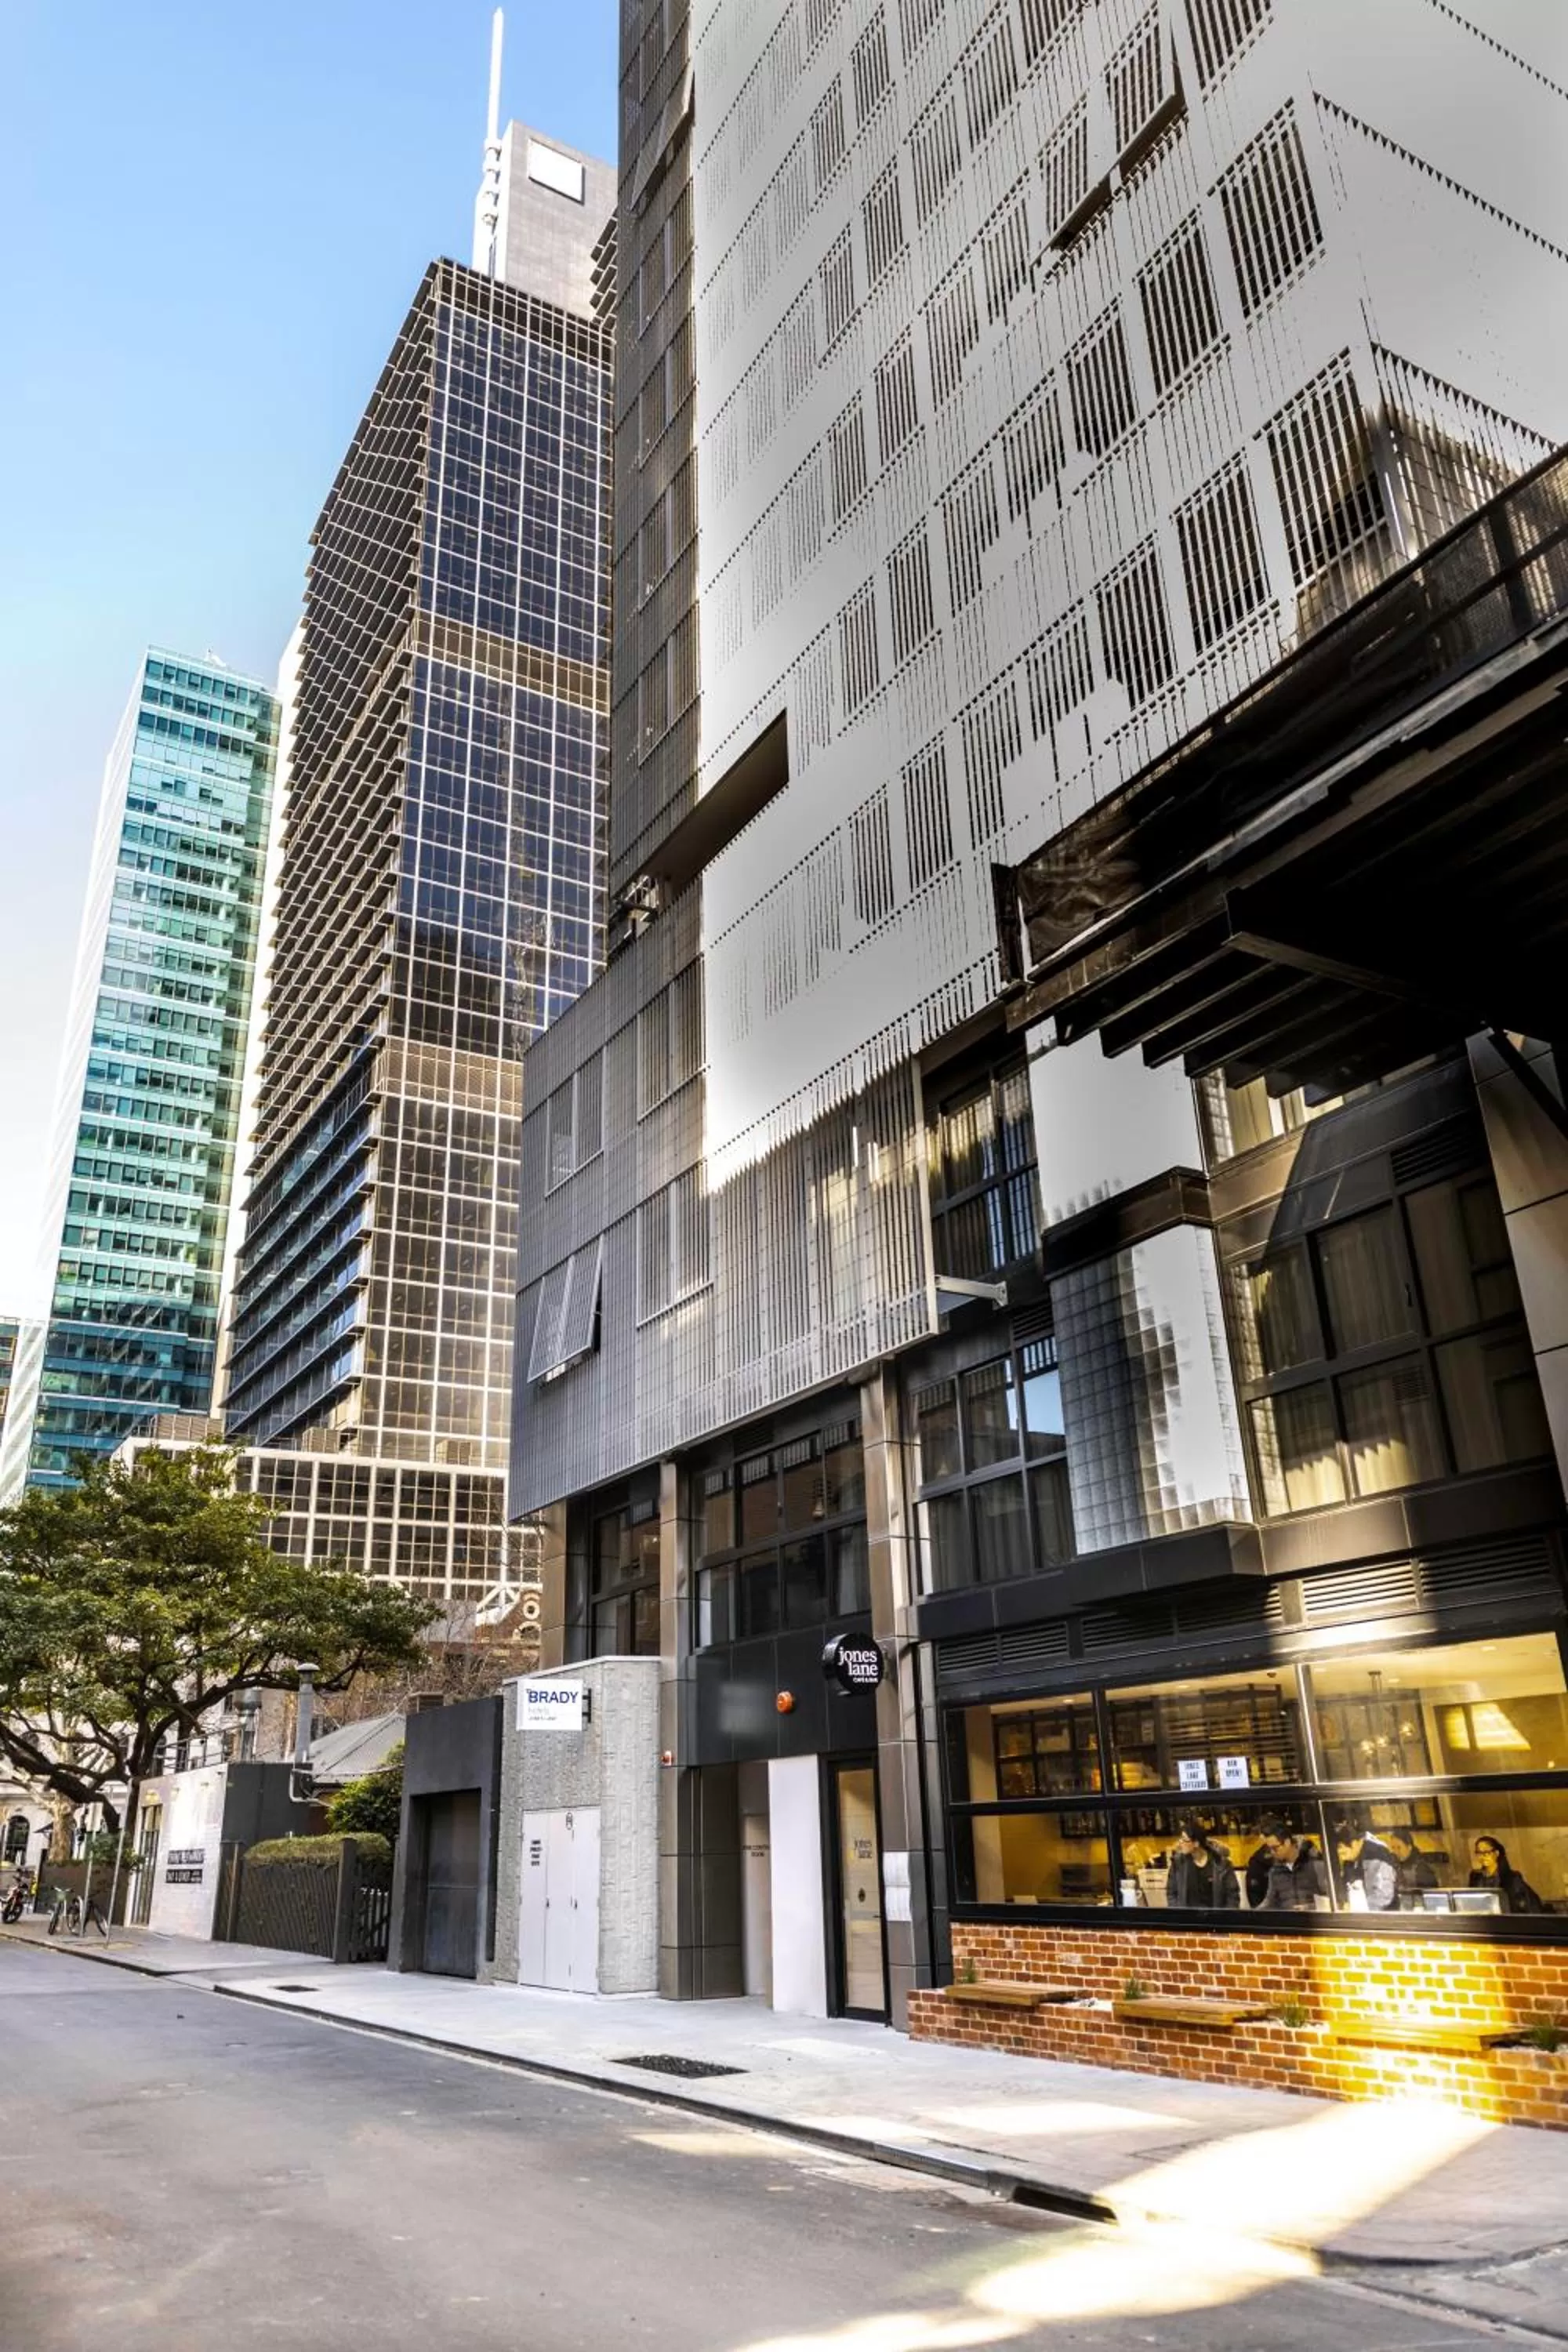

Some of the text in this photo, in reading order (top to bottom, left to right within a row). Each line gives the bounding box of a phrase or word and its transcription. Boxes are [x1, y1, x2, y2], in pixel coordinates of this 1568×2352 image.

[837, 1646, 877, 1666] jones
[848, 1661, 879, 1676] lane
[528, 1691, 579, 1704] BRADY
